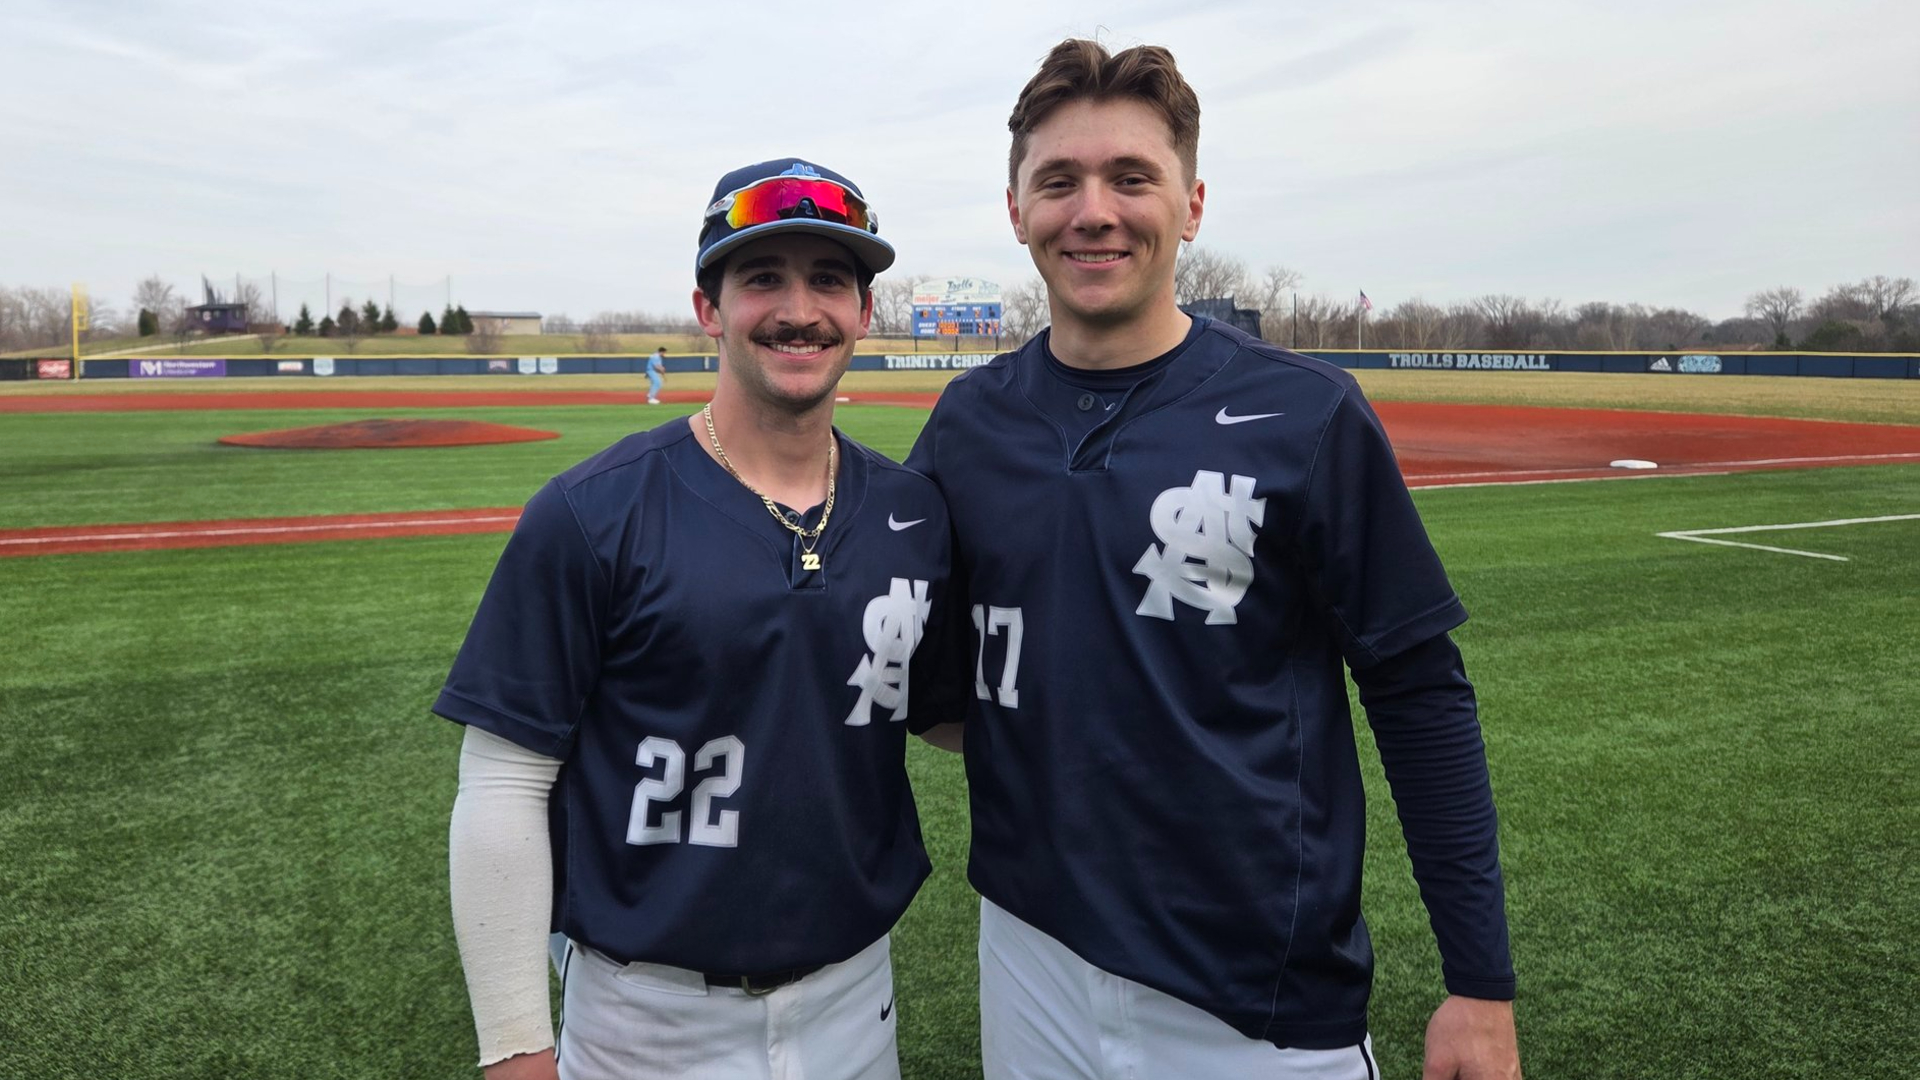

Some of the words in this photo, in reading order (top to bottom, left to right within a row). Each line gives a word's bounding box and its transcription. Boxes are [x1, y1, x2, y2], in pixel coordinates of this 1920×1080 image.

[885, 355, 949, 368] TRINITY
[1389, 353, 1453, 368] TROLLS
[1456, 354, 1550, 369] BASEBALL
[801, 554, 821, 570] 22
[971, 603, 1025, 710] 17
[625, 735, 746, 849] 22
